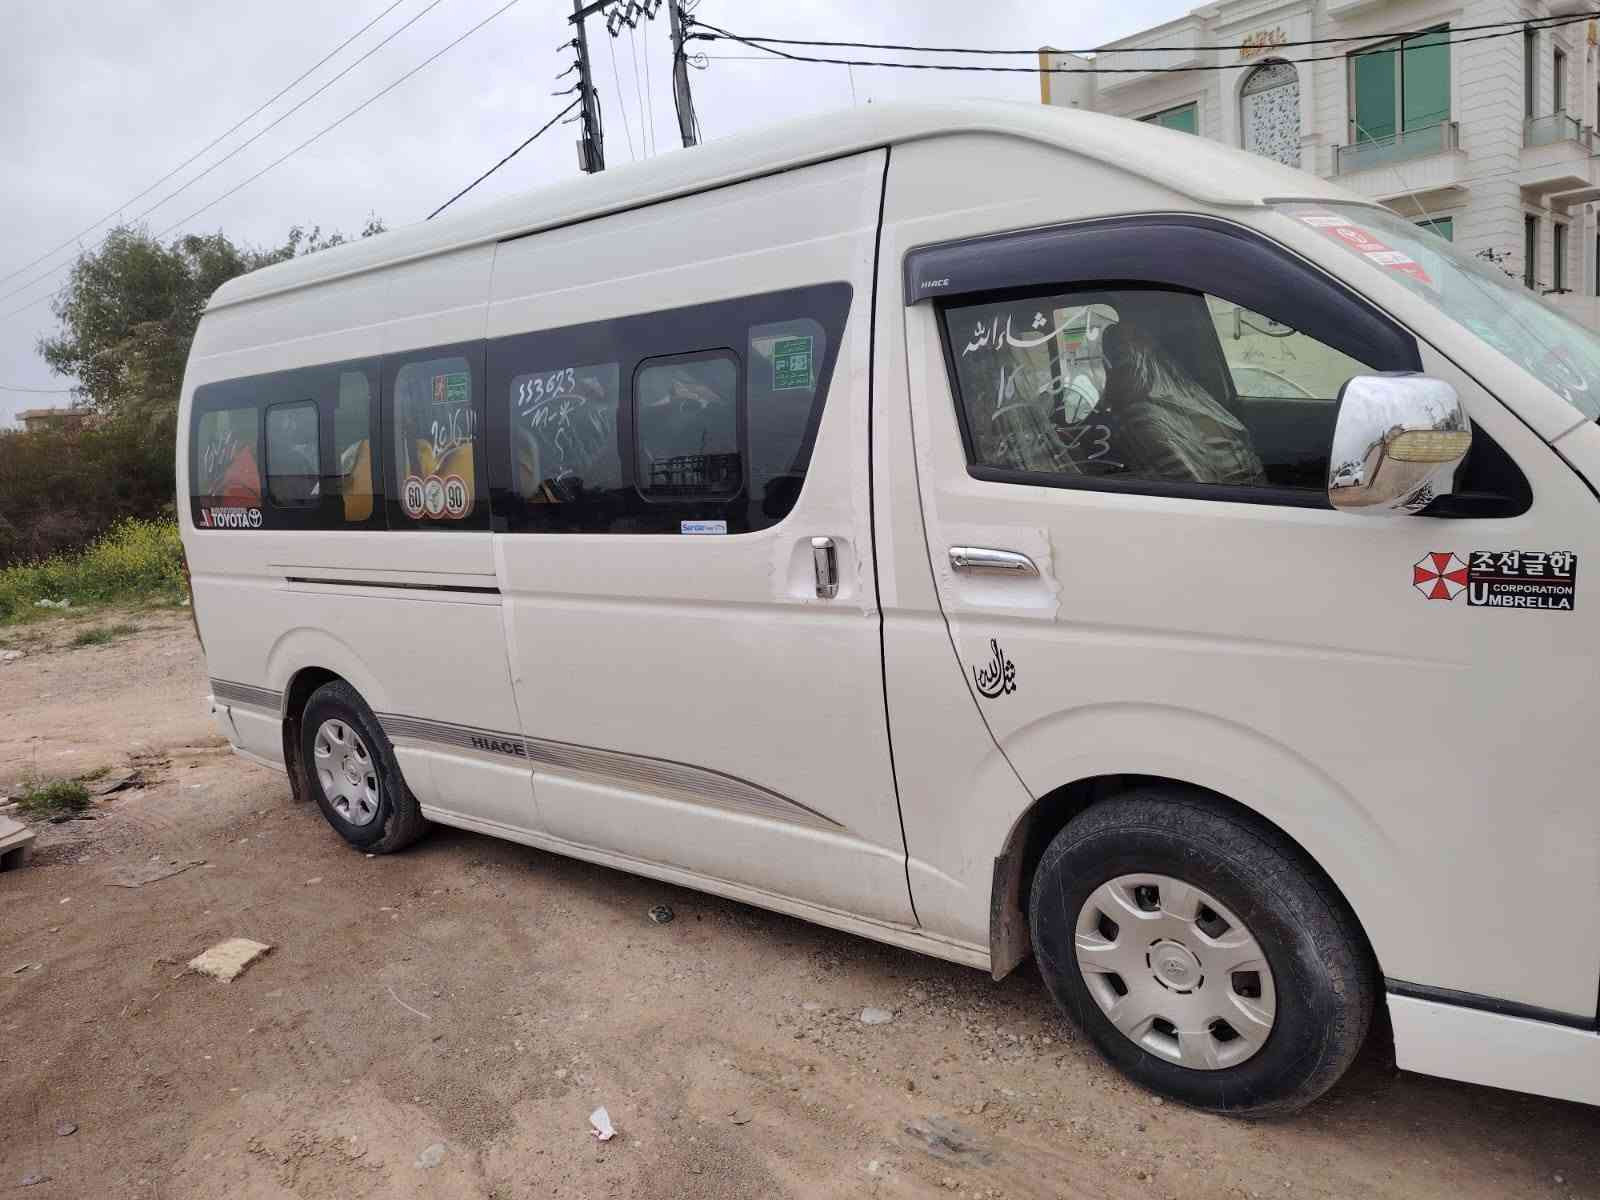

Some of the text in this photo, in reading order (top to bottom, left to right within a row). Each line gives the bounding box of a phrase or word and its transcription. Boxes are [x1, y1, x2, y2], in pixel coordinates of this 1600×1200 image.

[920, 278, 950, 289] HIACE
[408, 486, 422, 508] 60
[448, 486, 463, 508] 90
[211, 513, 250, 527] TOYOTA
[1469, 582, 1571, 609] UMBRELLA
[1492, 583, 1573, 595] CORPORATION
[471, 736, 527, 757] HIACE
